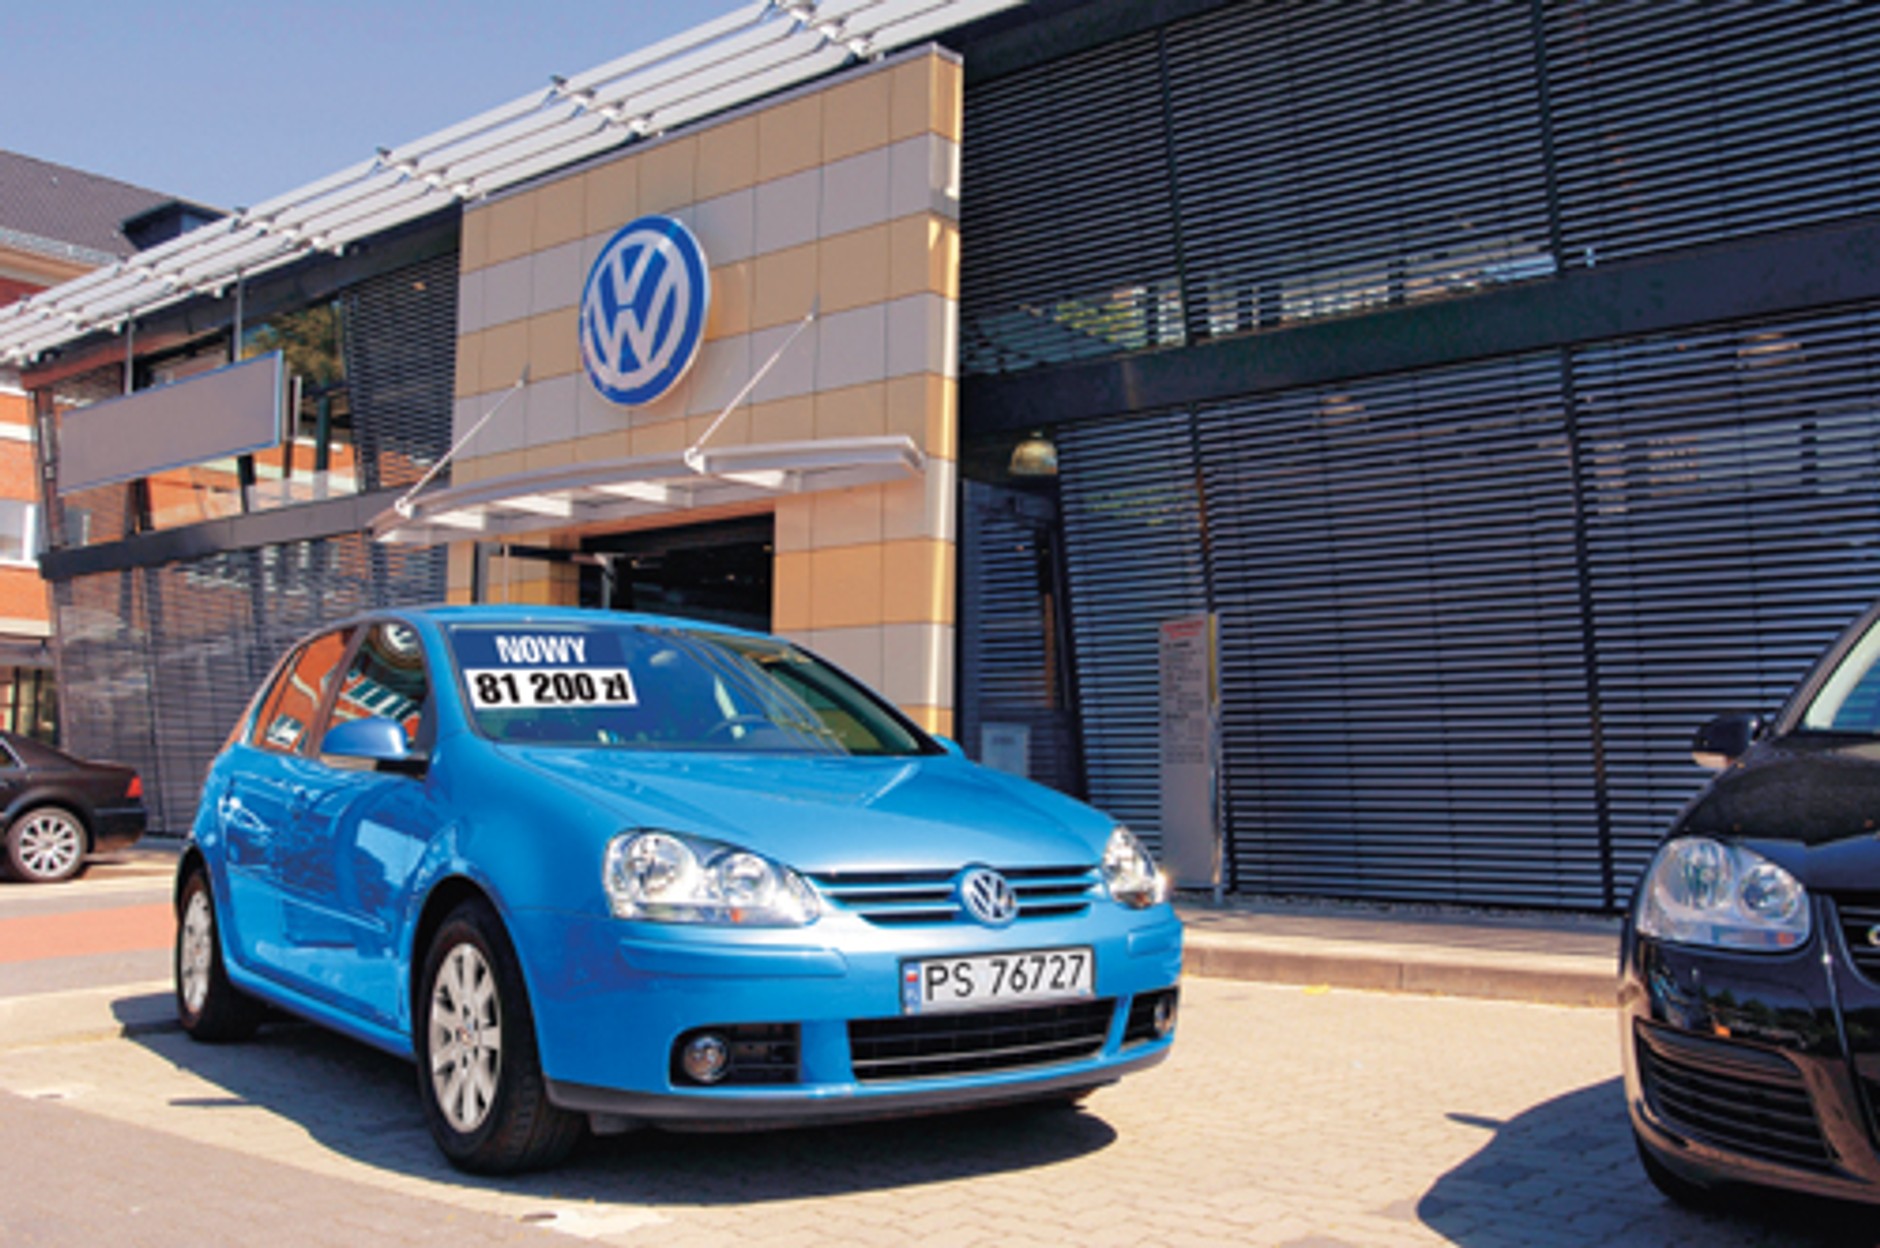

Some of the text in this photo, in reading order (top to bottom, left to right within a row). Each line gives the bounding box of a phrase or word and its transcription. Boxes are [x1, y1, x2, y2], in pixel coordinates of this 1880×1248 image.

[495, 634, 587, 664] NOWY
[475, 672, 521, 704] 81
[529, 672, 597, 704] 200
[925, 953, 1086, 1001] PS 76727
